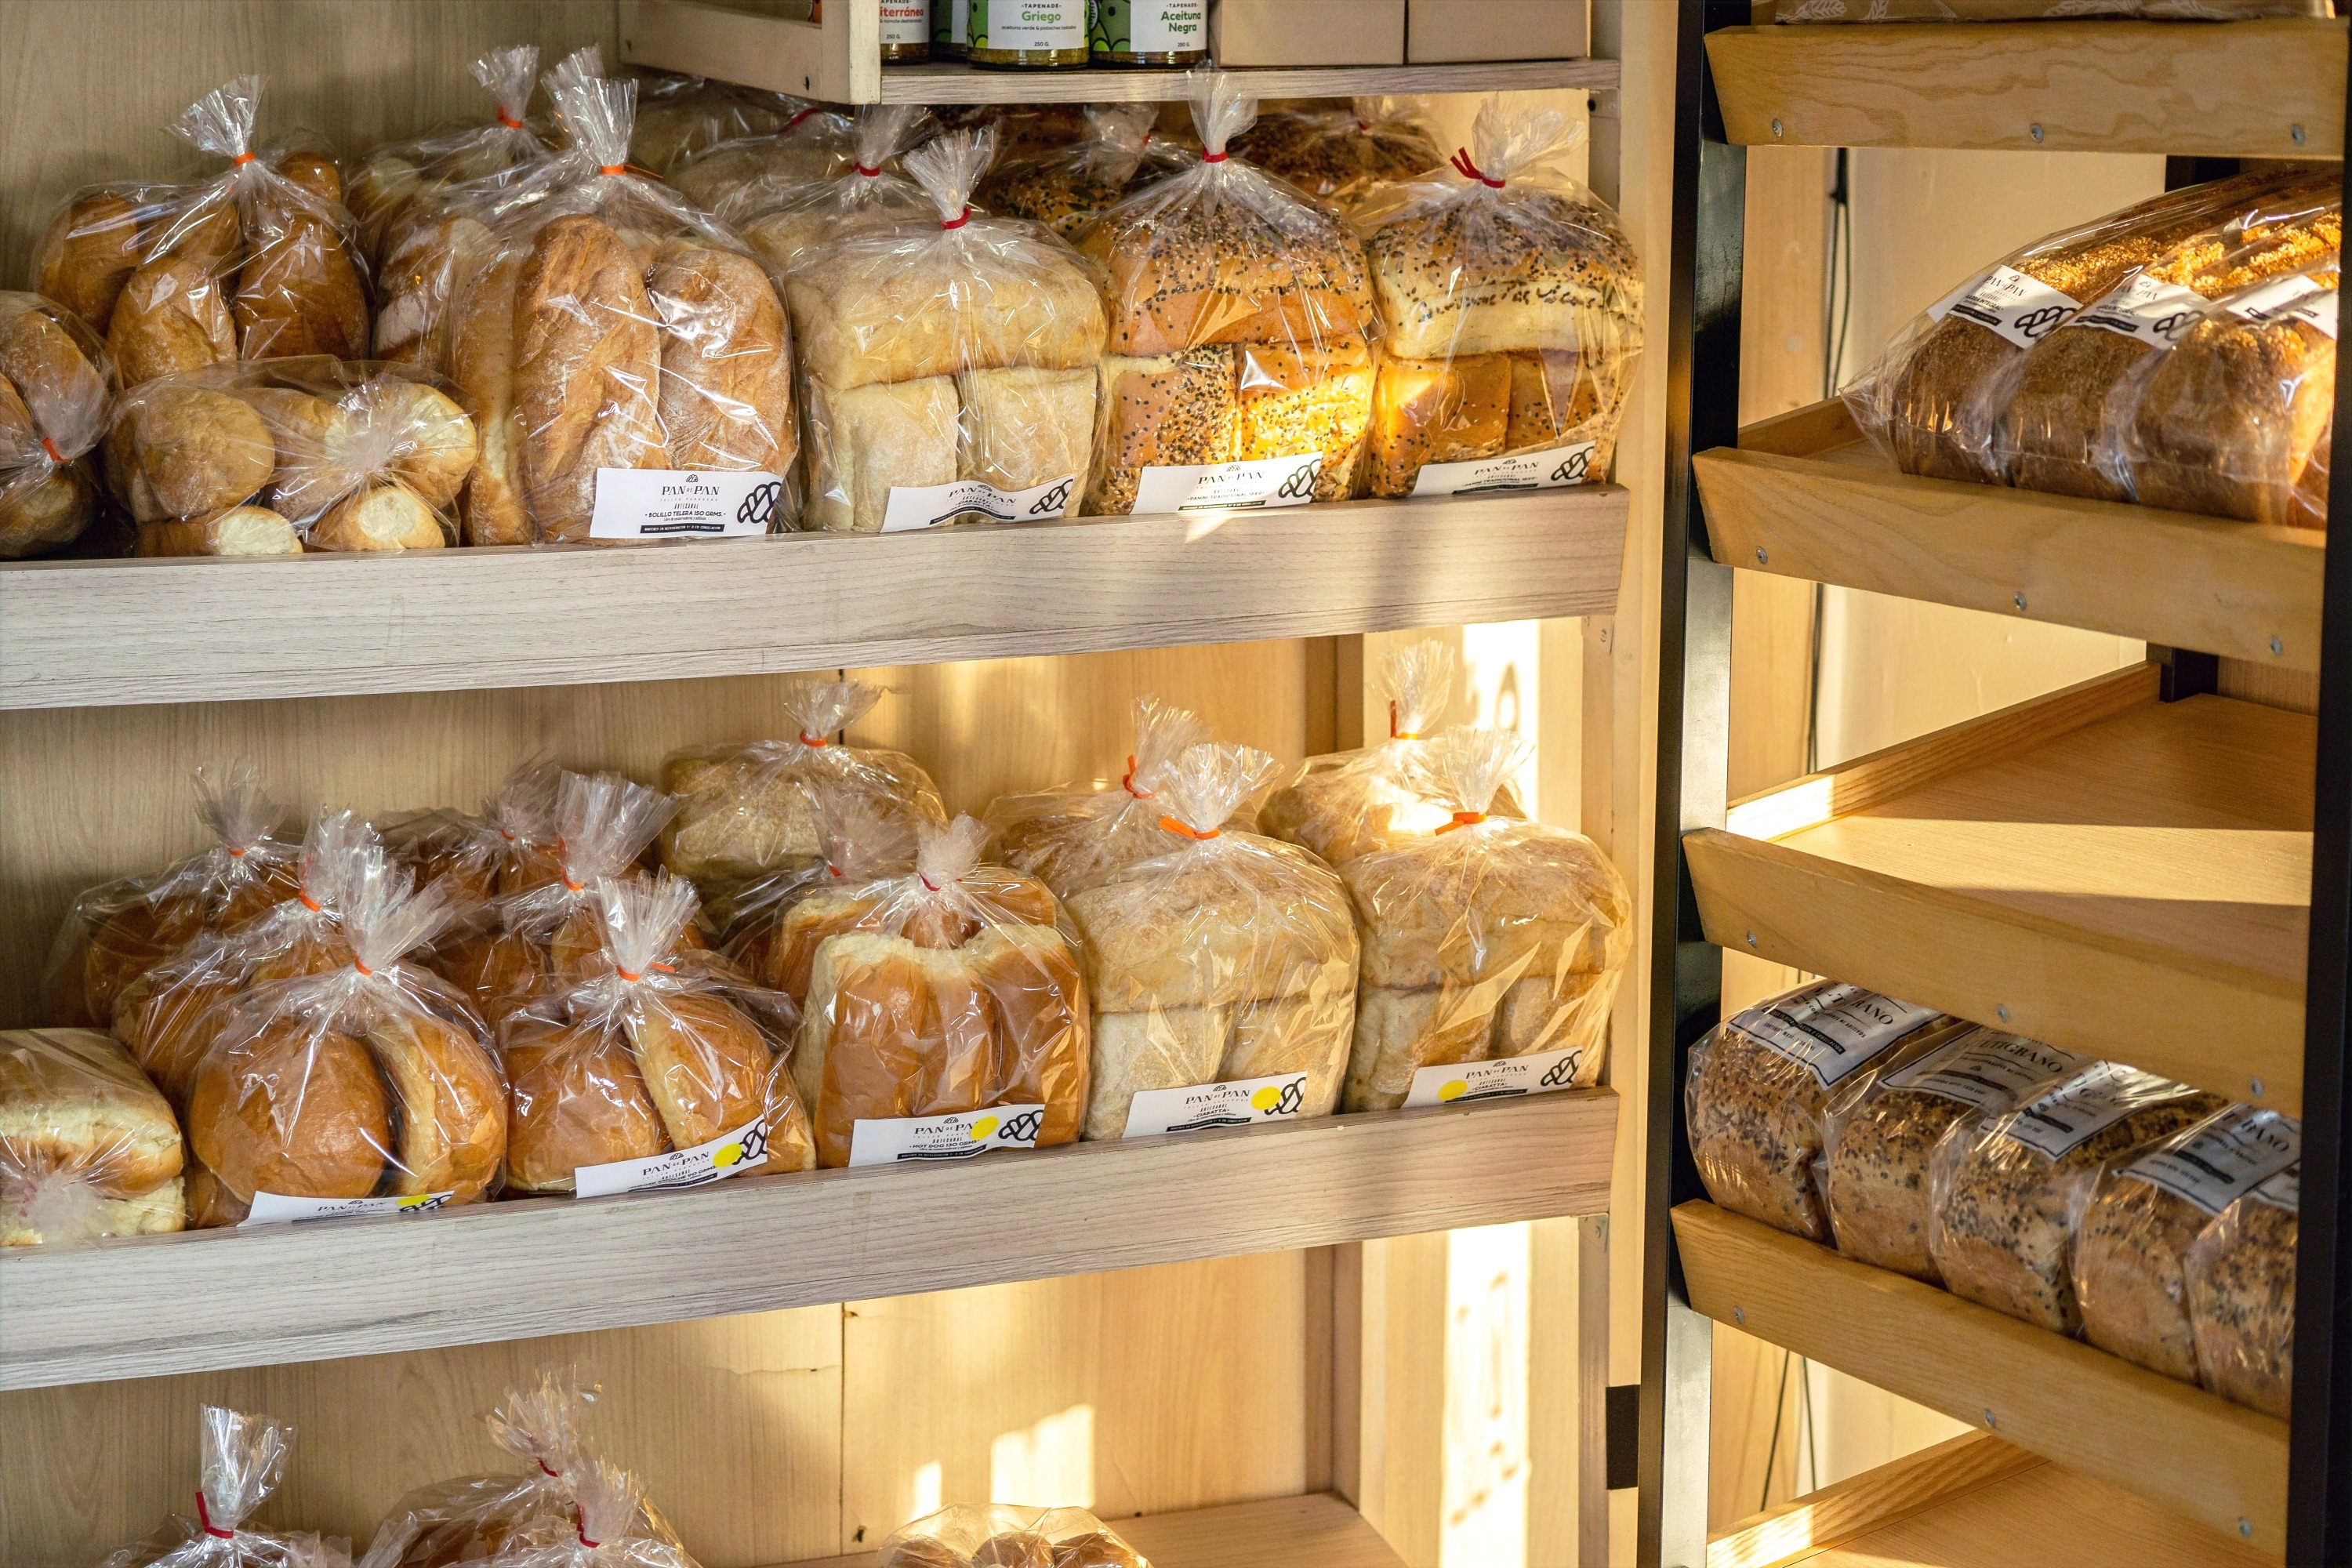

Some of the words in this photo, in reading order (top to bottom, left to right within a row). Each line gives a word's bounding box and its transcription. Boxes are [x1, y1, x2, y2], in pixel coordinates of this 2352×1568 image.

[880, 6, 924, 16] iterráneo
[1160, 11, 1201, 21] Aceituna
[1022, 11, 1062, 24] Griego
[1168, 23, 1197, 34] Negra
[2004, 284, 2027, 296] PAN
[1474, 466, 1501, 475] PAN
[1512, 462, 1539, 470] PAN
[1198, 475, 1226, 485] PAN
[1237, 472, 1264, 481] PAN
[662, 486, 686, 495] PAN
[694, 486, 720, 495] PAN
[949, 487, 977, 497] PAN
[987, 492, 1017, 503] PAN
[1845, 1023, 1866, 1038] ADITIVOS
[1979, 1040, 2063, 1073] LTIGRANO
[1465, 1069, 1492, 1079] PAN
[1185, 1094, 1213, 1104] PAN
[1196, 1109, 1227, 1117] CIABATTA
[956, 1122, 978, 1131] PA
[642, 1163, 671, 1175] PAN
[682, 1152, 709, 1165] PAN
